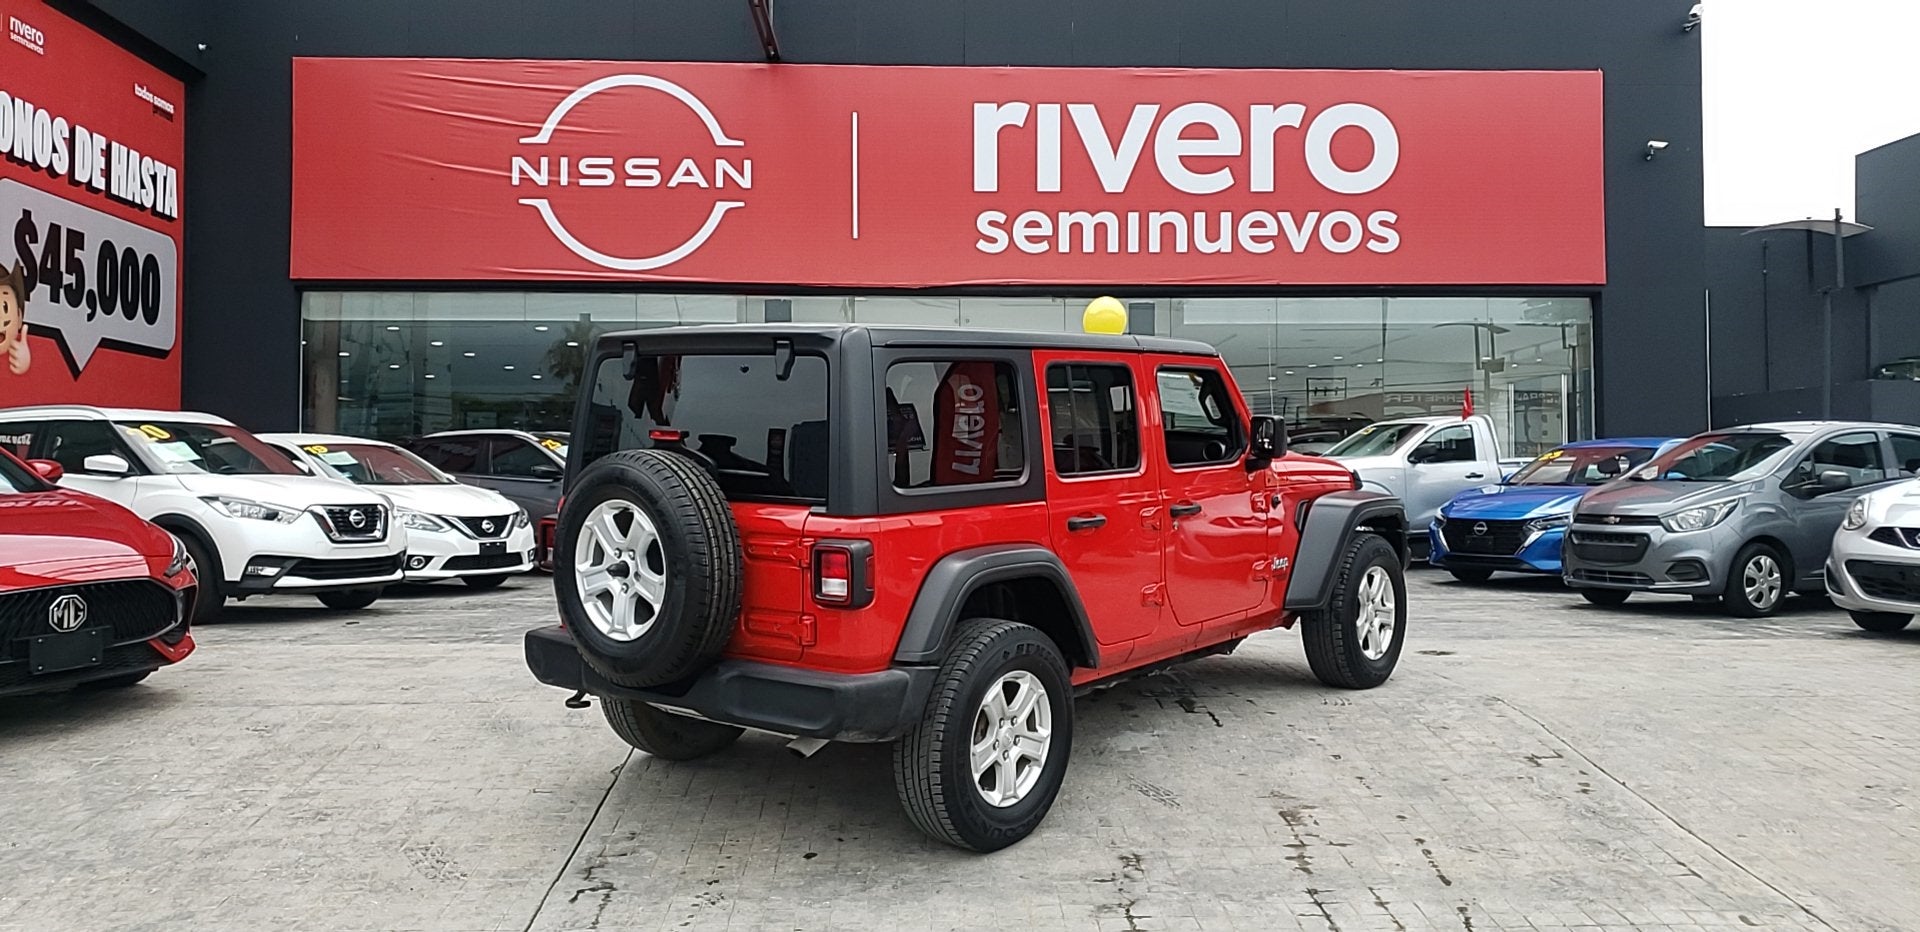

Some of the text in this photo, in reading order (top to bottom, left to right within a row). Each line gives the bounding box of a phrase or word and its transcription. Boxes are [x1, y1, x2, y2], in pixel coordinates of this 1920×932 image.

[135, 83, 153, 103] todos
[153, 95, 174, 114] somos
[973, 101, 1400, 195] rivero
[75, 124, 106, 191] DE
[110, 140, 178, 219] HASTA
[511, 156, 753, 190] NISSAN
[976, 209, 1400, 254] seminuevos
[14, 208, 162, 326] $45,000
[53, 598, 84, 629] MG
